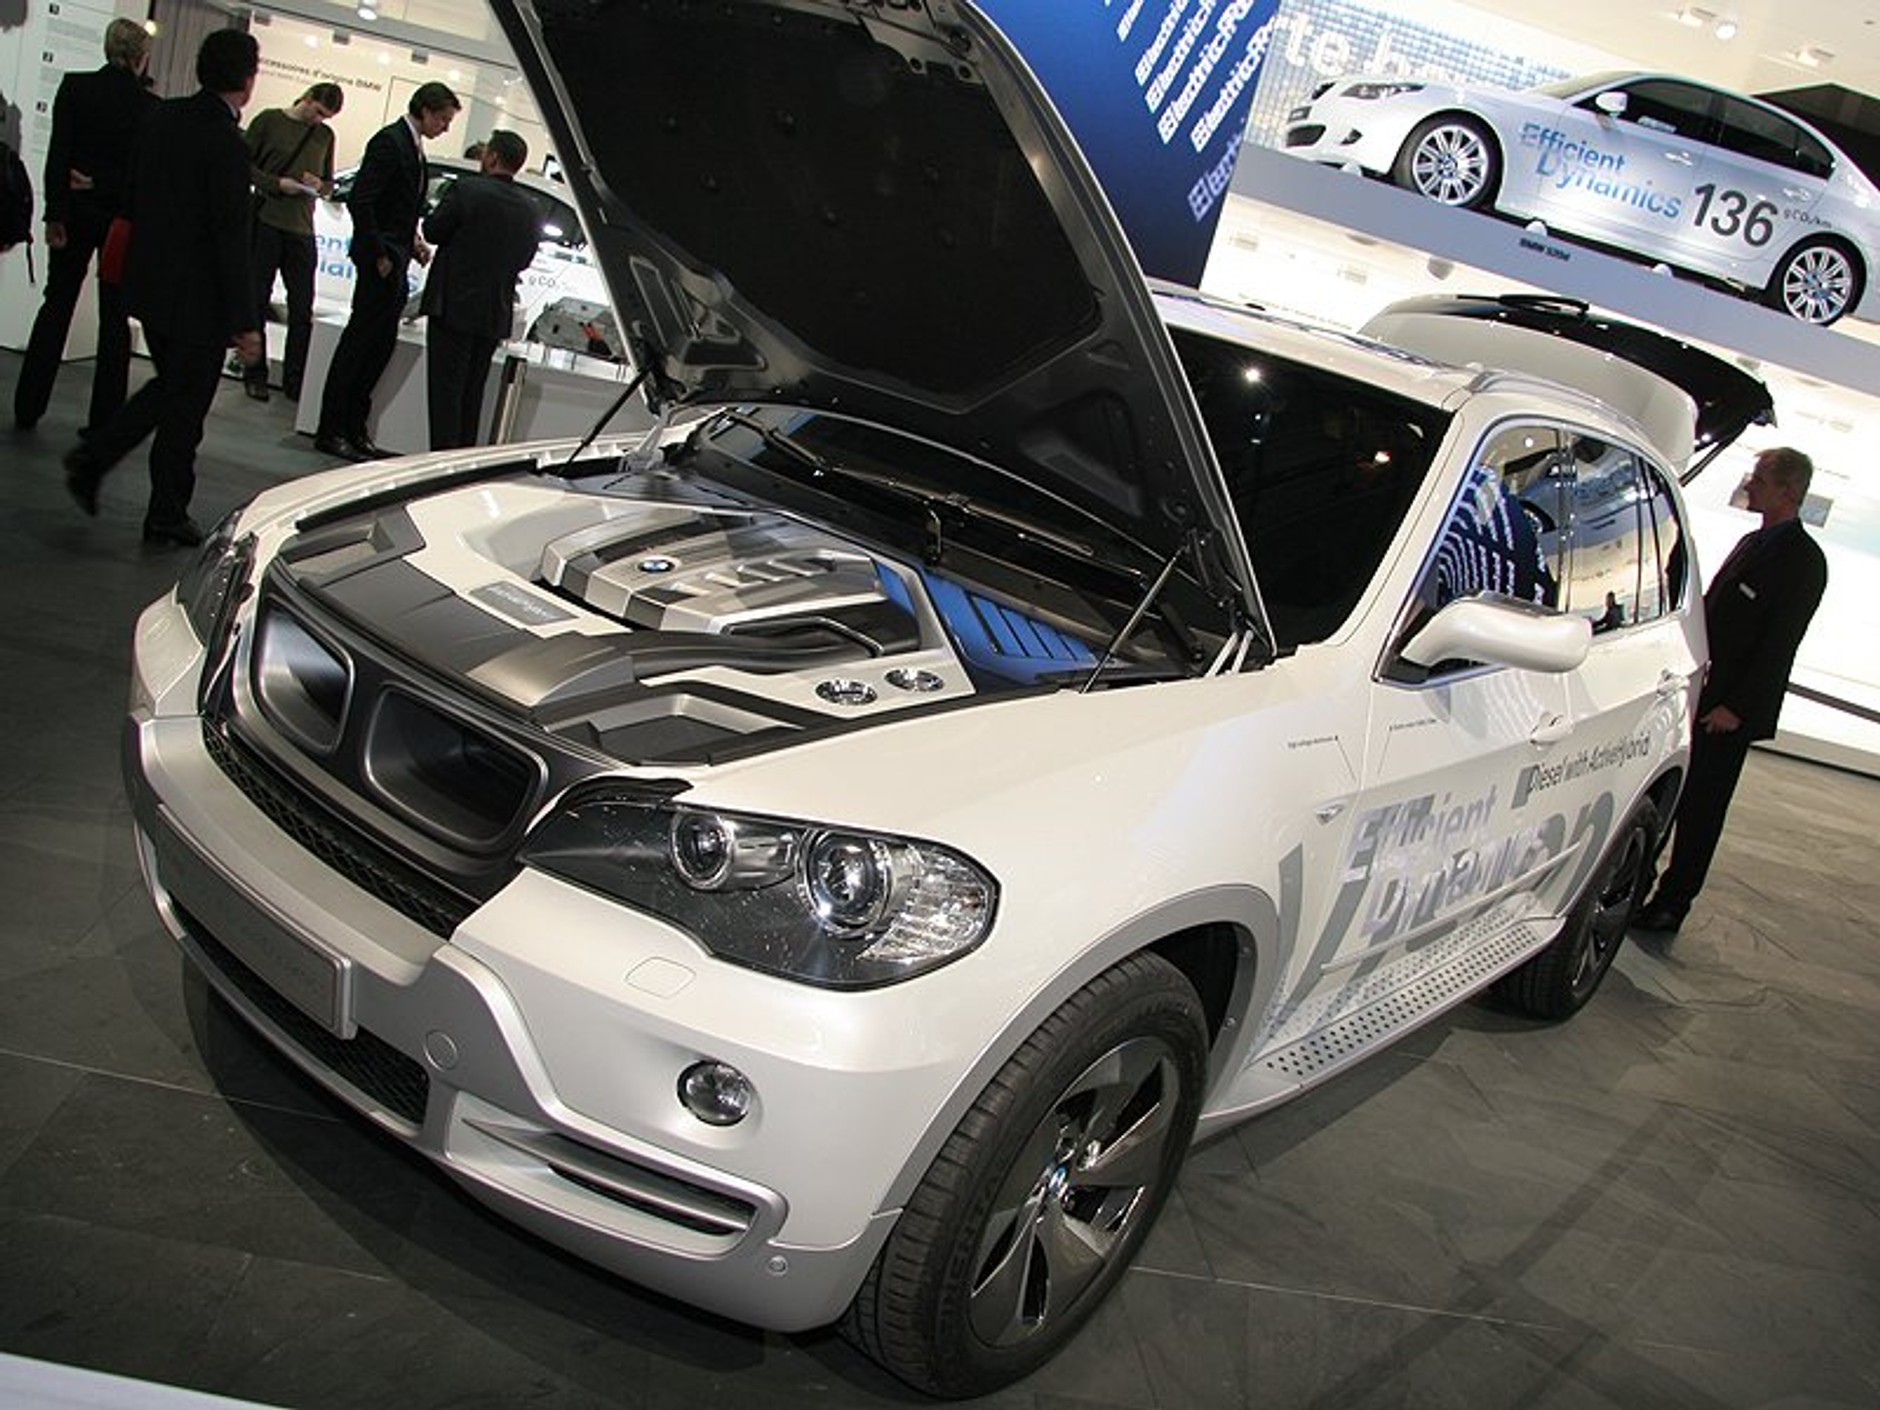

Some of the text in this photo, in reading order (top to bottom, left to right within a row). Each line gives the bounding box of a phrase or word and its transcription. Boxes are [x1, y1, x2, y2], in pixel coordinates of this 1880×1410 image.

[1520, 123, 1626, 172] Efficient
[1536, 150, 1682, 218] Dynamics
[1694, 182, 1779, 247] 136
